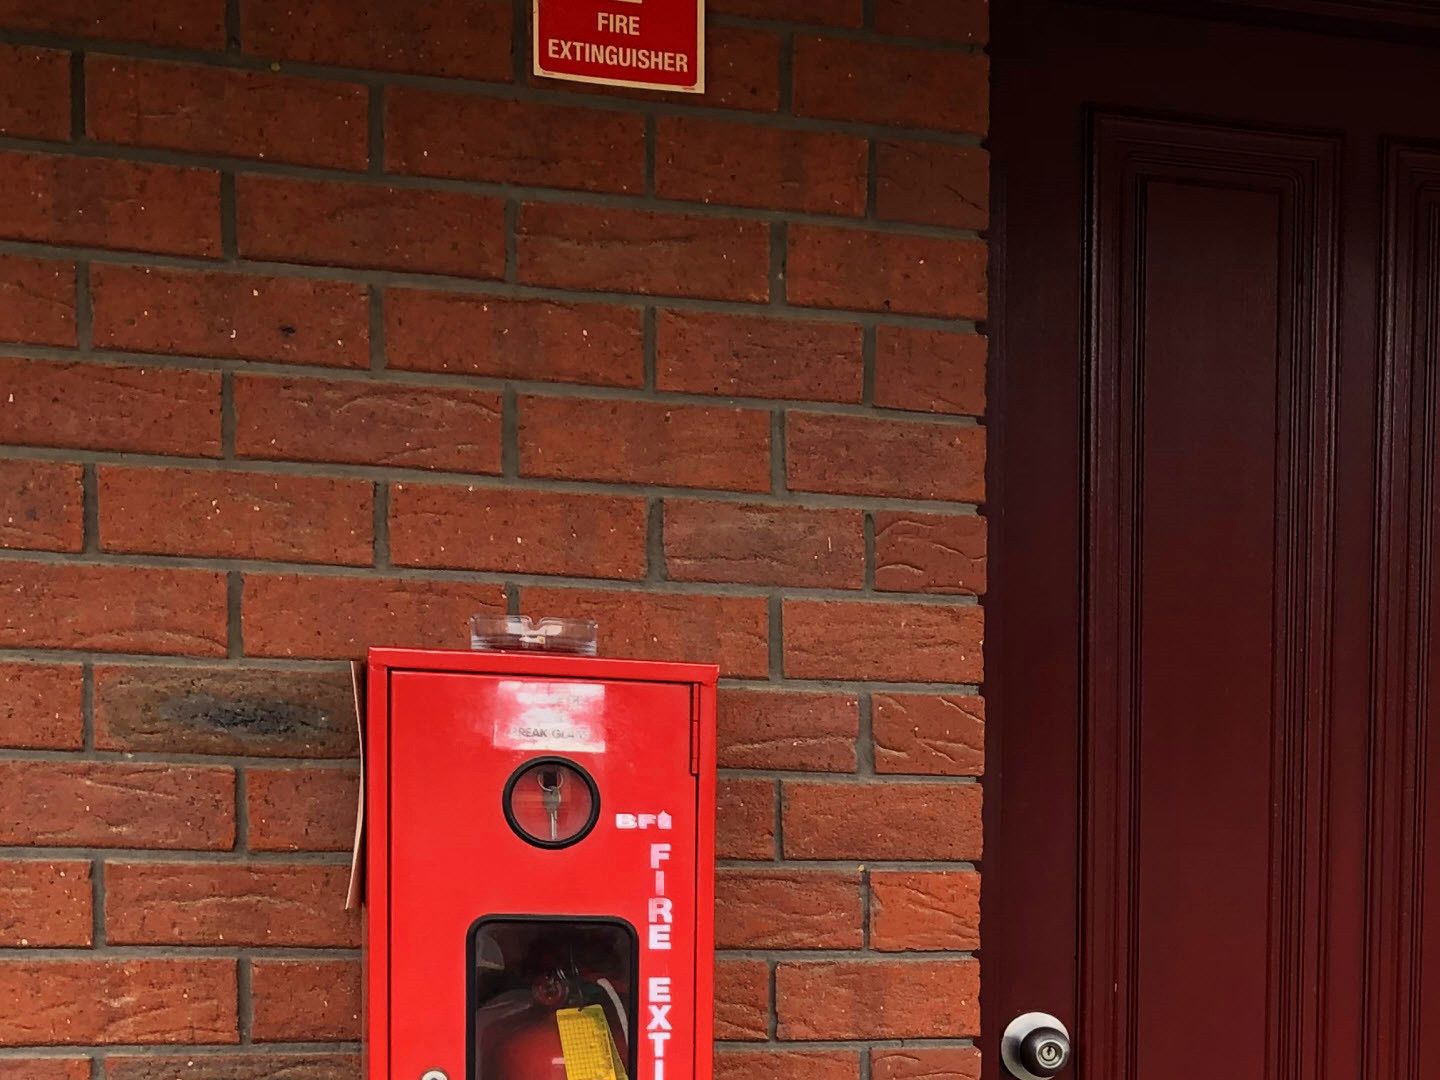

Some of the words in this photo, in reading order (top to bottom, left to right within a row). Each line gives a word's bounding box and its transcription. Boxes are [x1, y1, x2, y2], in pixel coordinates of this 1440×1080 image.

[597, 12, 641, 36] FIRE
[548, 38, 689, 73] EXTINGUISHER
[648, 843, 673, 950] FIRE
